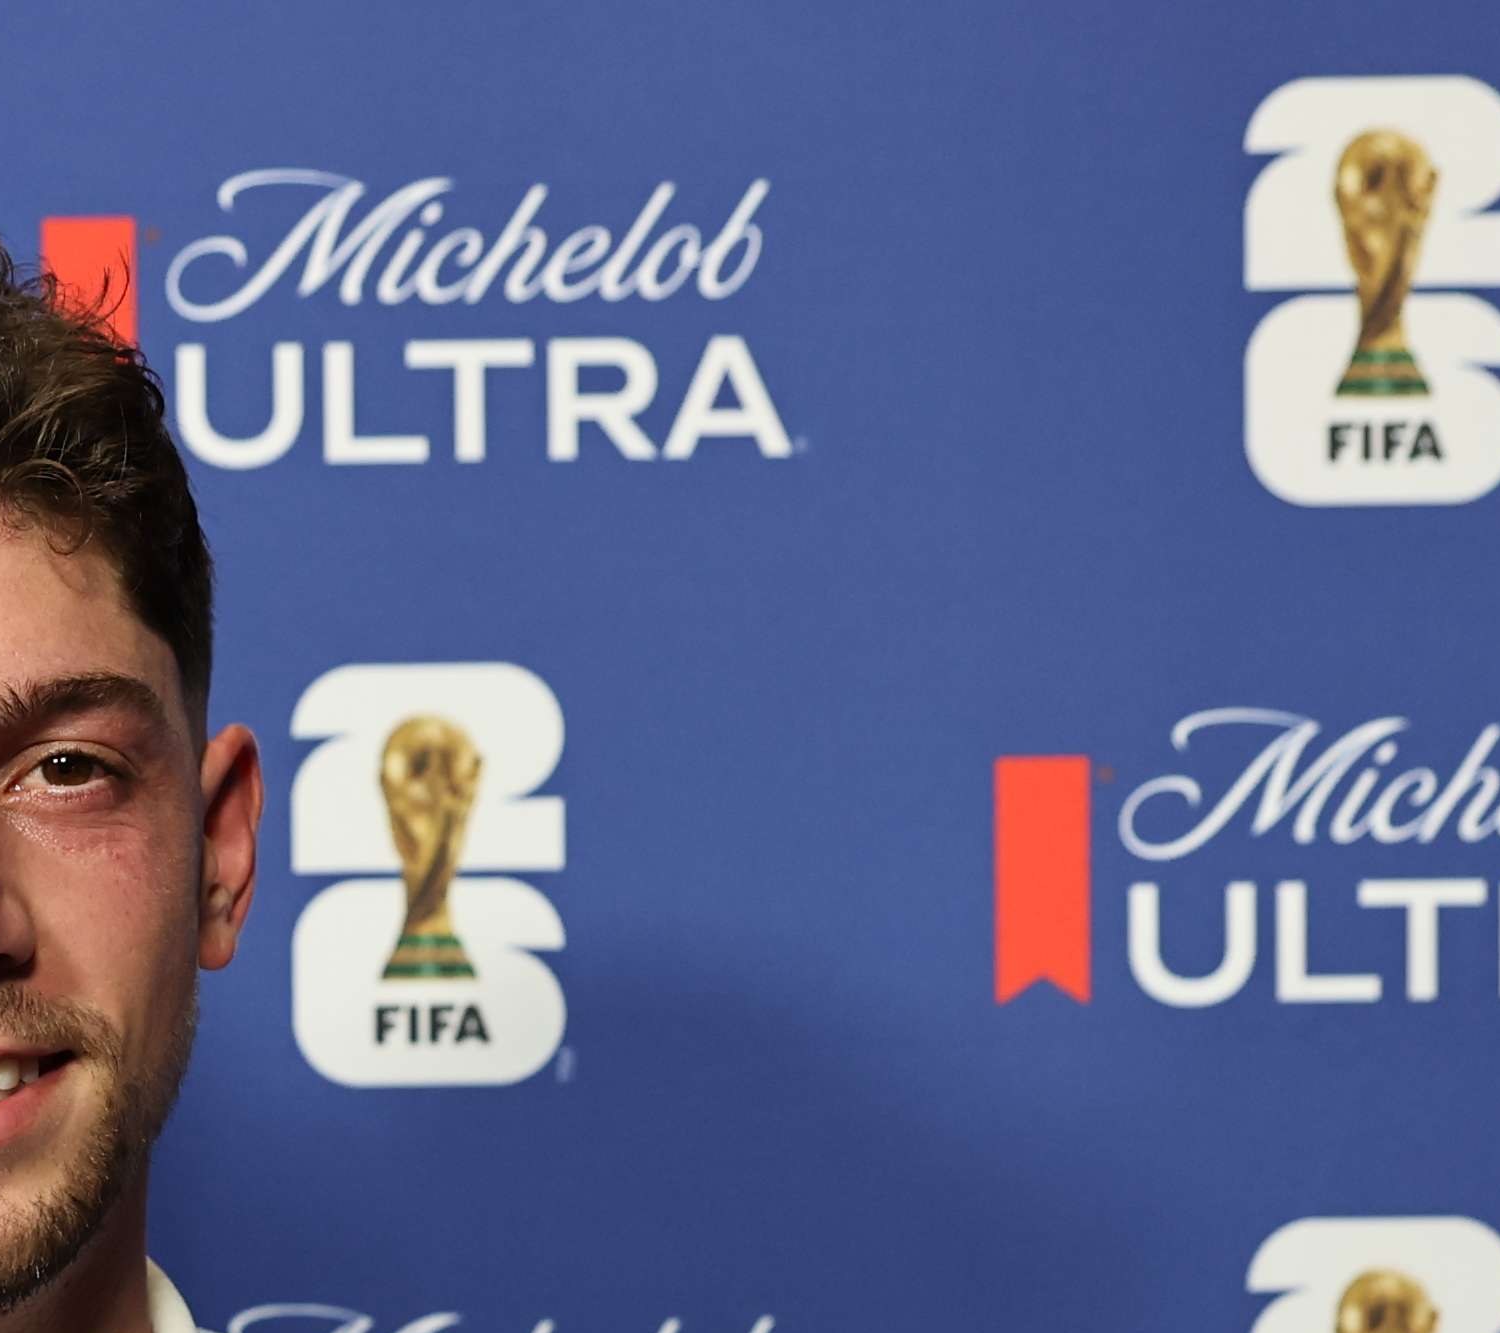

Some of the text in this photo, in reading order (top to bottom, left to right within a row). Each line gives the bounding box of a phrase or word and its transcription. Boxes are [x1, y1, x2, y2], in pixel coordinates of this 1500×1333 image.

[164, 167, 771, 324] Michelob
[173, 333, 794, 472] ULTRA
[1326, 421, 1444, 463] FIFA
[373, 1002, 492, 1047] FIFA
